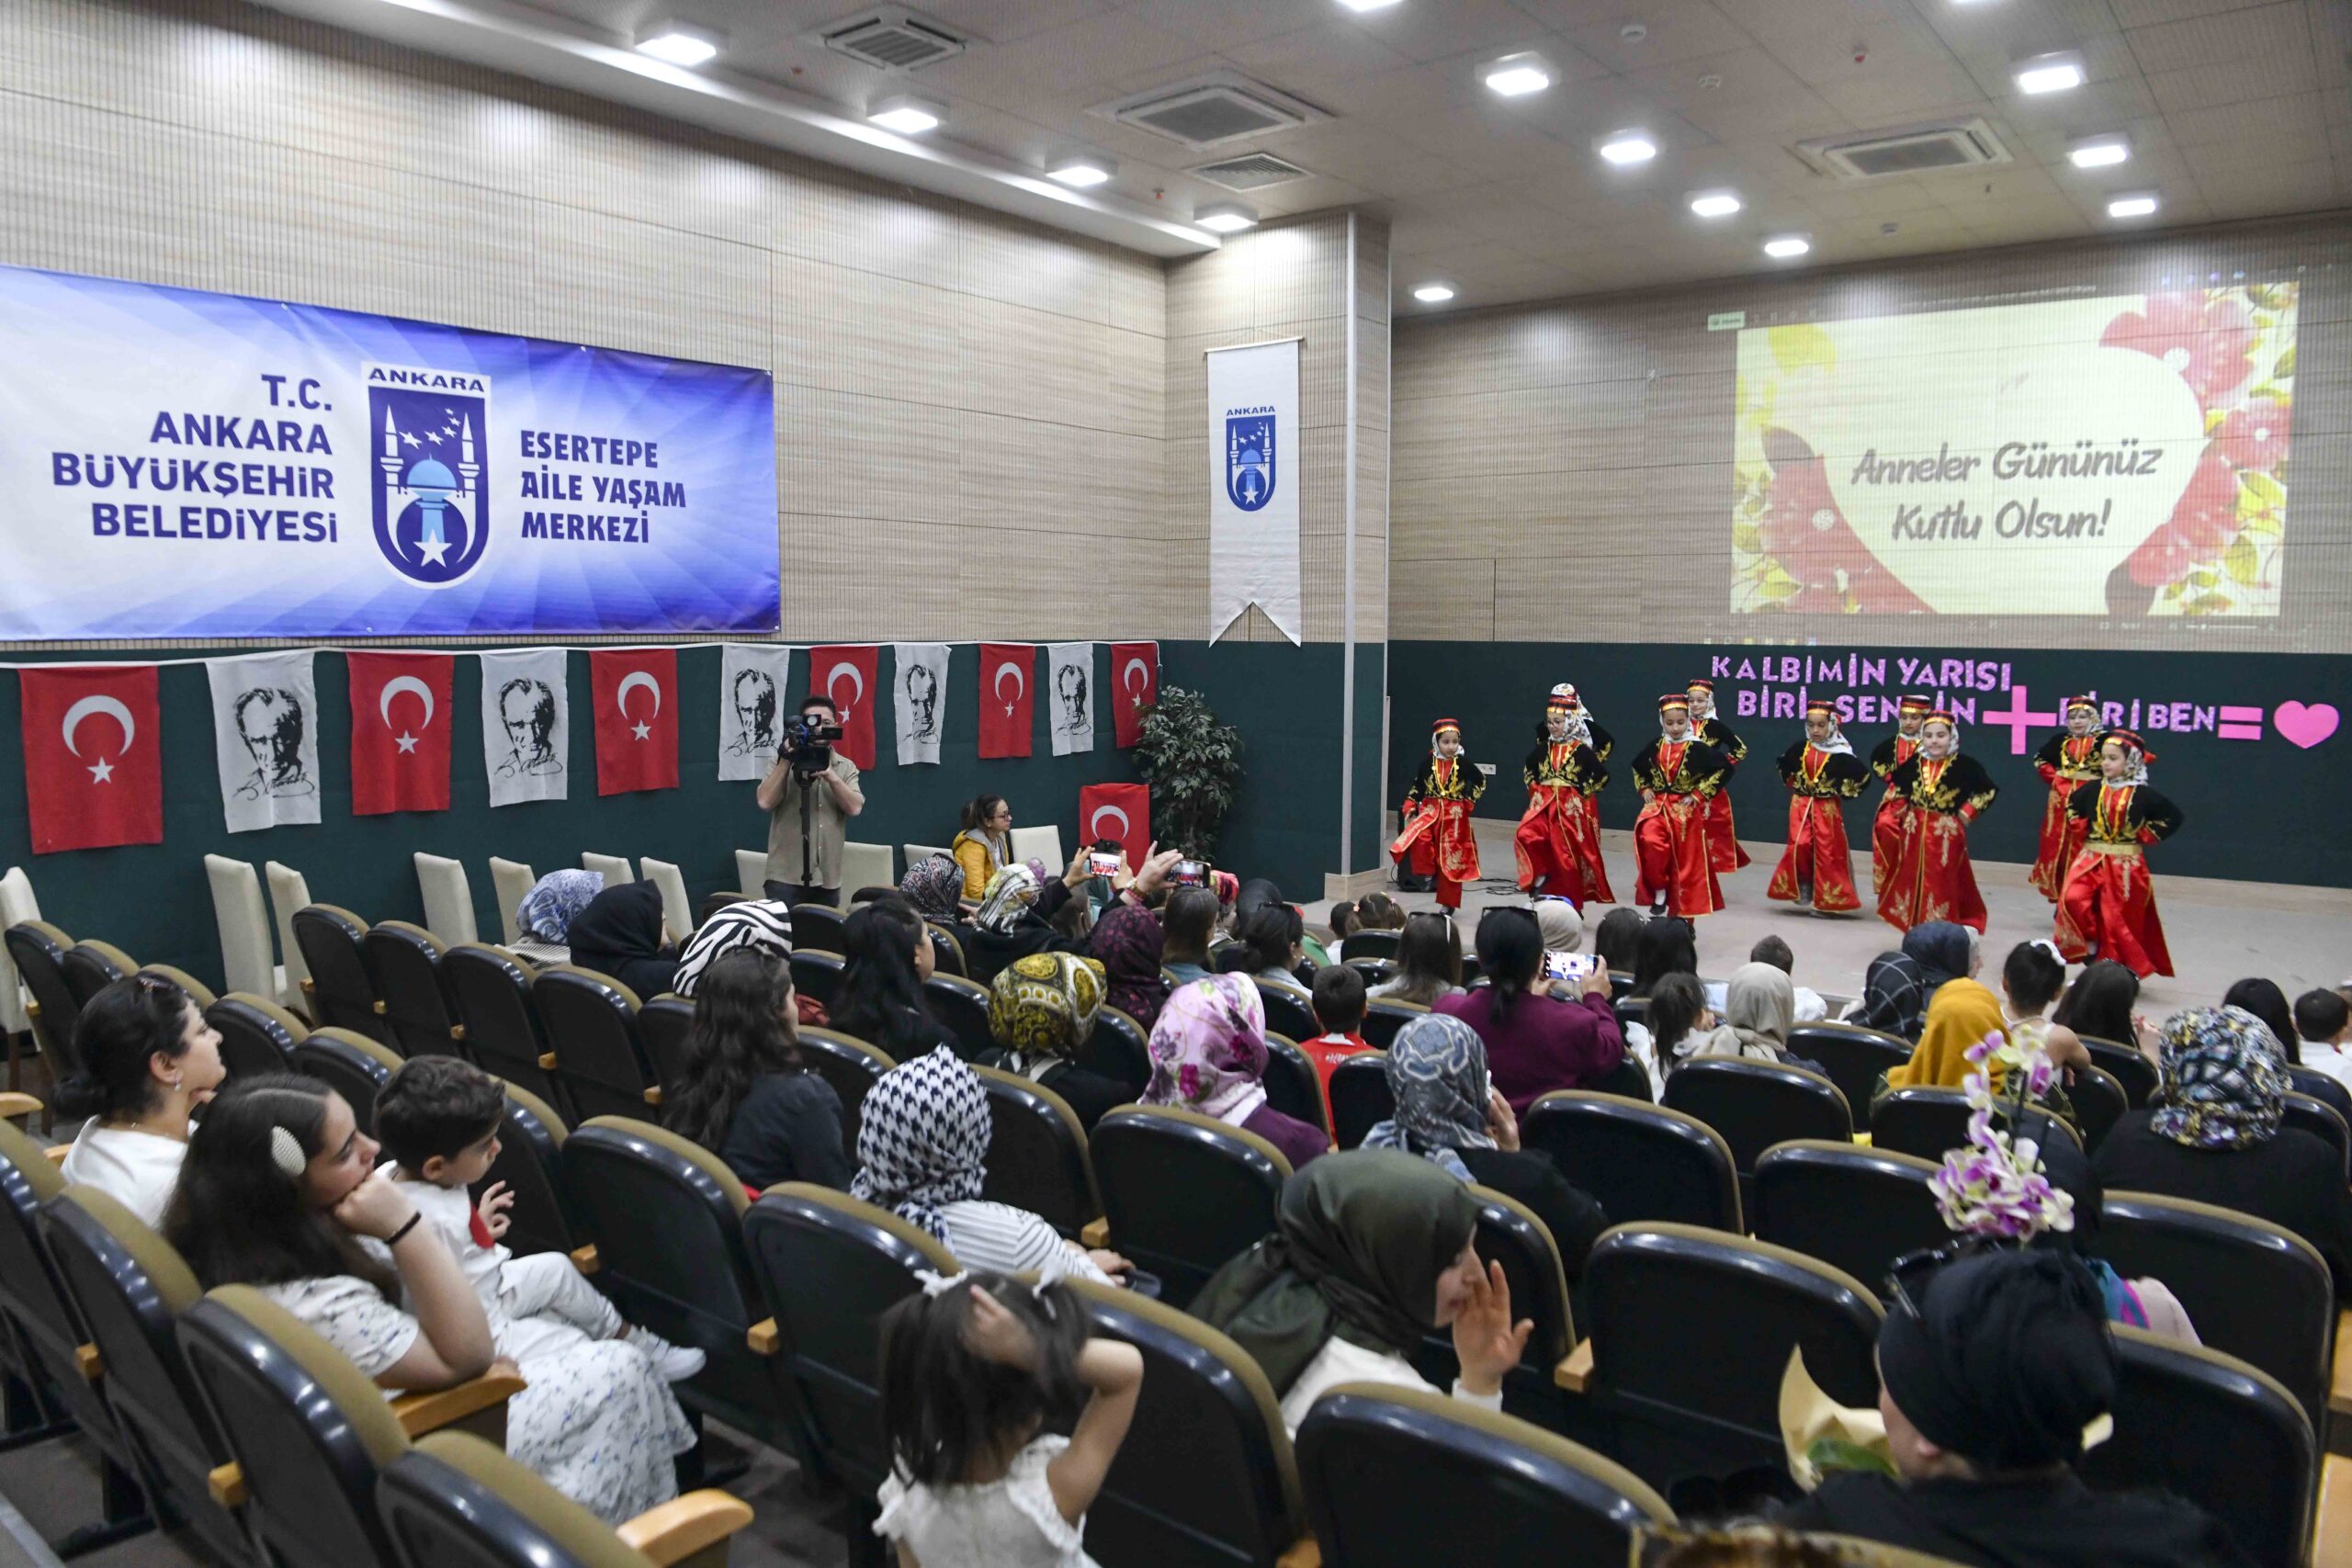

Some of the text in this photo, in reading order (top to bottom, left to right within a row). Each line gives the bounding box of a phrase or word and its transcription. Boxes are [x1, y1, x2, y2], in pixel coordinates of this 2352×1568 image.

[261, 374, 333, 412] T.C.
[368, 367, 485, 393] ANKARA
[1227, 405, 1275, 416] ANKARA
[149, 411, 334, 456] ANKARA
[520, 430, 659, 468] ESERTEPE
[1850, 438, 2164, 485] Anneler Gününüz
[521, 465, 687, 510] AİLE YAŞAM
[521, 510, 650, 544] MERKEZİ
[1891, 497, 2112, 541] Kutlu Olsun!
[1896, 657, 2012, 693] YARISI
[1737, 684, 1808, 720] BİRİ
[1835, 691, 1976, 727] SENİN
[2147, 702, 2216, 733] BEN
